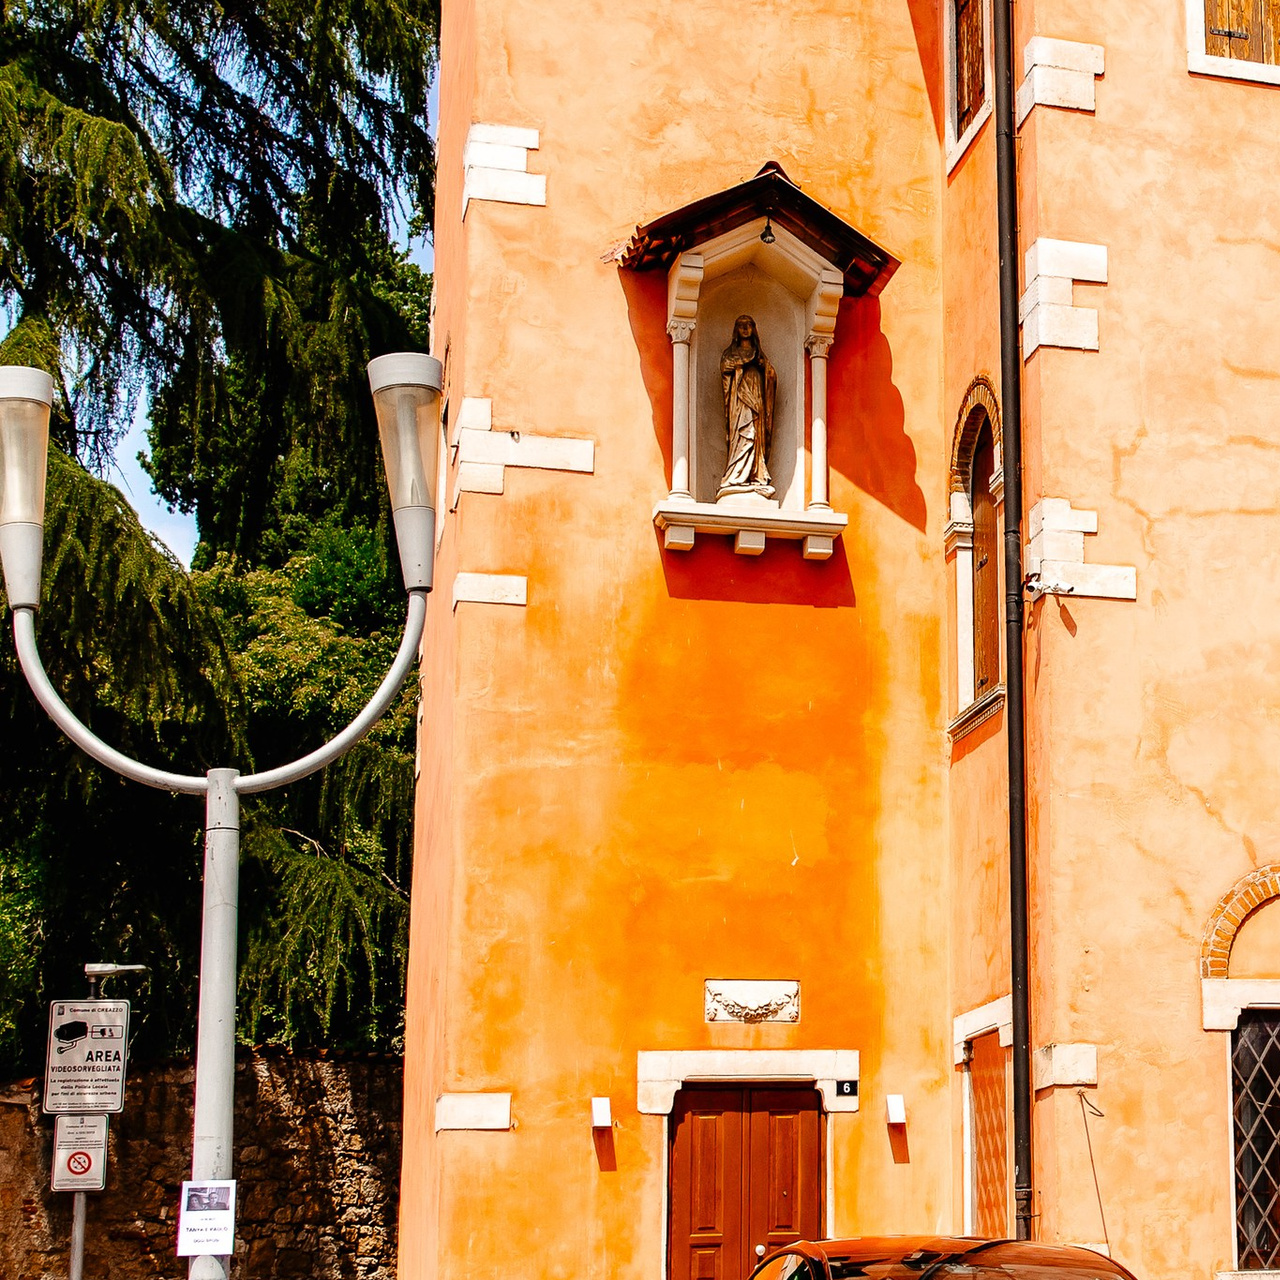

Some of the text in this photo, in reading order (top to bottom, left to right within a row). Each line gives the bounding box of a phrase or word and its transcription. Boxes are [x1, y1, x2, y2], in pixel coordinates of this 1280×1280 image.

[85, 1050, 121, 1062] AREA
[50, 1065, 121, 1073] VIDEOSORVEGLIATA
[843, 1082, 851, 1093] 6
